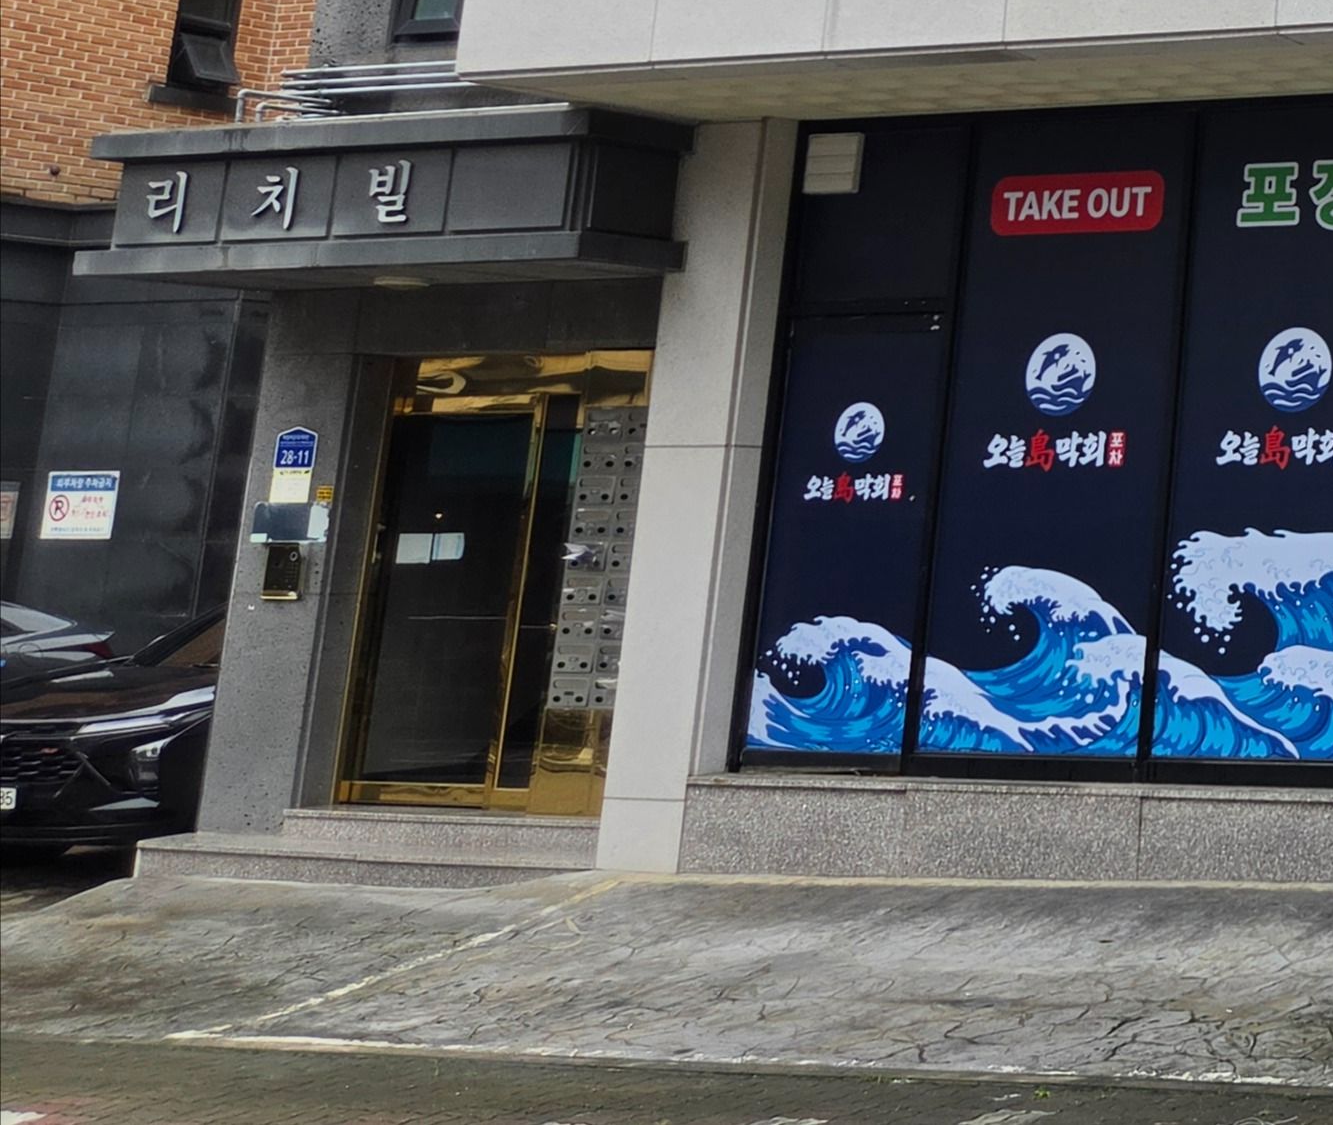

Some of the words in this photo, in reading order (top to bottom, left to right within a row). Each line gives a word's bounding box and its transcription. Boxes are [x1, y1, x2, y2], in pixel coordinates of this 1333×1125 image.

[146, 159, 411, 233] 리치빌
[1003, 189, 1080, 221] TAKE
[1087, 186, 1152, 218] OUT
[280, 450, 310, 465] 28-11
